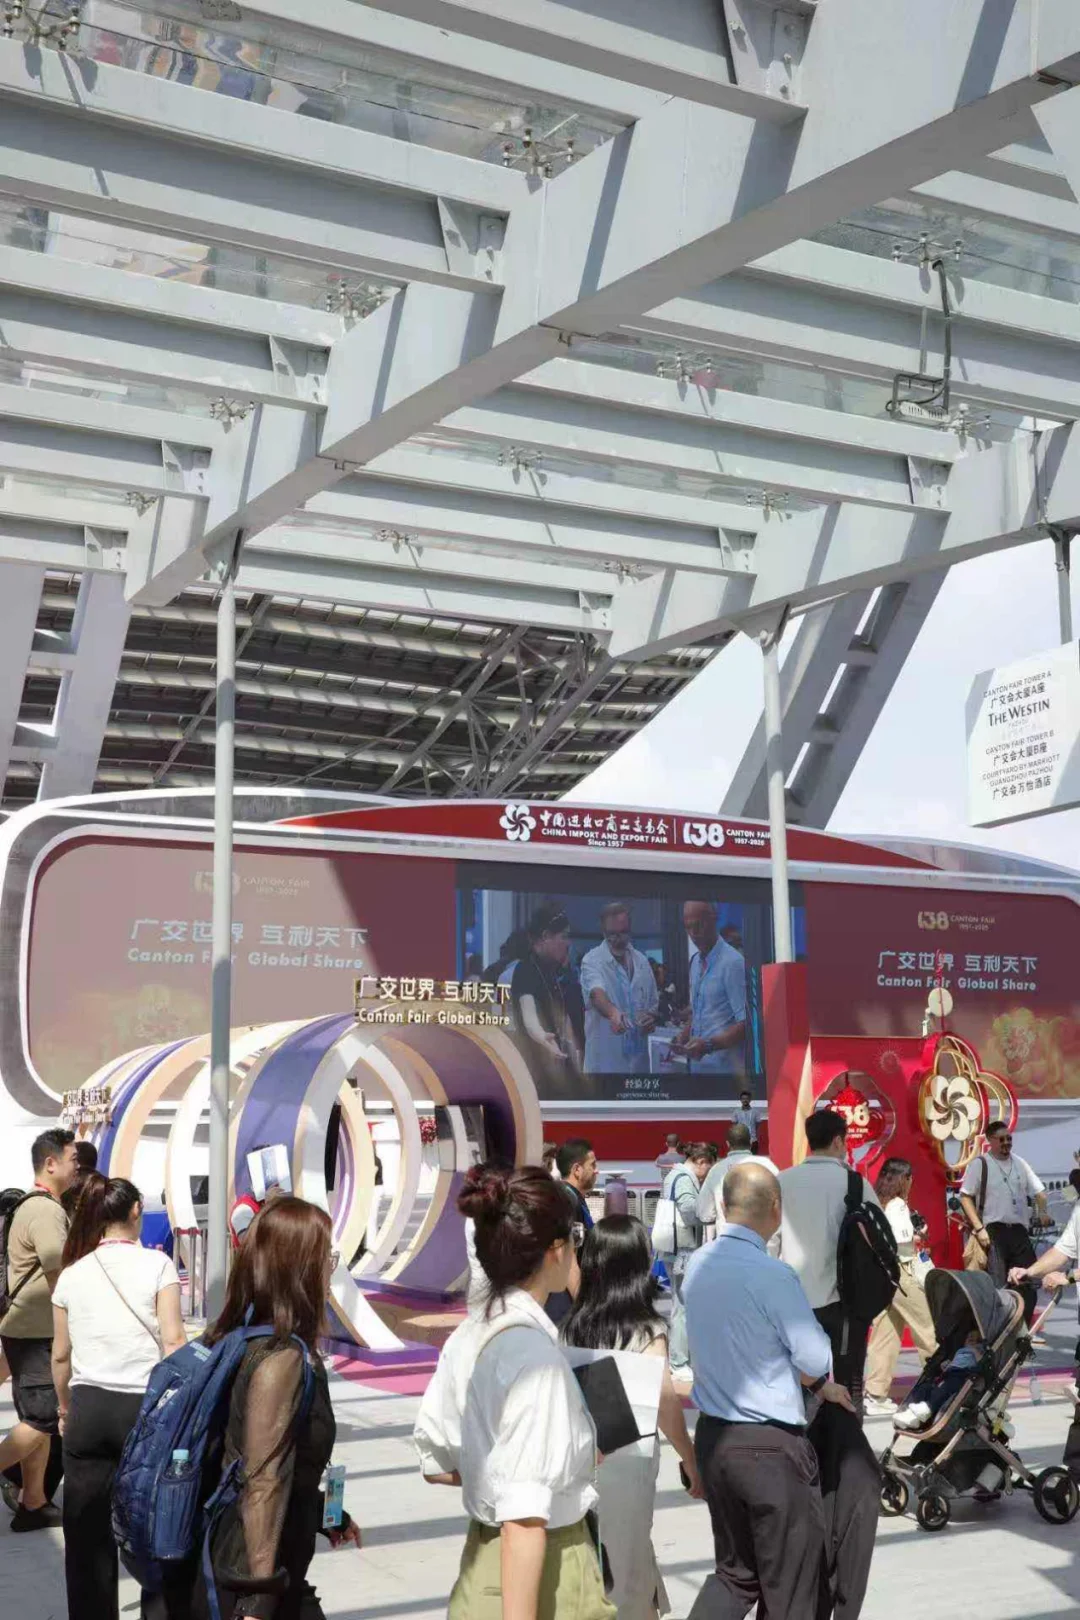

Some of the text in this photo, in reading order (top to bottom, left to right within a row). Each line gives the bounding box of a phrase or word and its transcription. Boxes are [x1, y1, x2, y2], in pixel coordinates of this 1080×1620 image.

[988, 698, 1050, 727] THE WESTIN
[541, 828, 668, 844] CHINA IMPORT AND EXPORT FAIR
[588, 838, 624, 848] Since 1957
[726, 829, 755, 838] CANTON
[259, 924, 368, 948] 互利天下
[128, 947, 194, 963] Canton
[248, 951, 308, 967] Global
[313, 954, 363, 969] Share
[877, 950, 1038, 974] 广交世界 互利天下
[359, 975, 512, 1004] 广交世界 互利天下
[877, 974, 922, 987] Canton
[957, 976, 998, 990] Global
[1002, 978, 1037, 991] Share
[359, 1007, 510, 1026] Canton Fair Global Share
